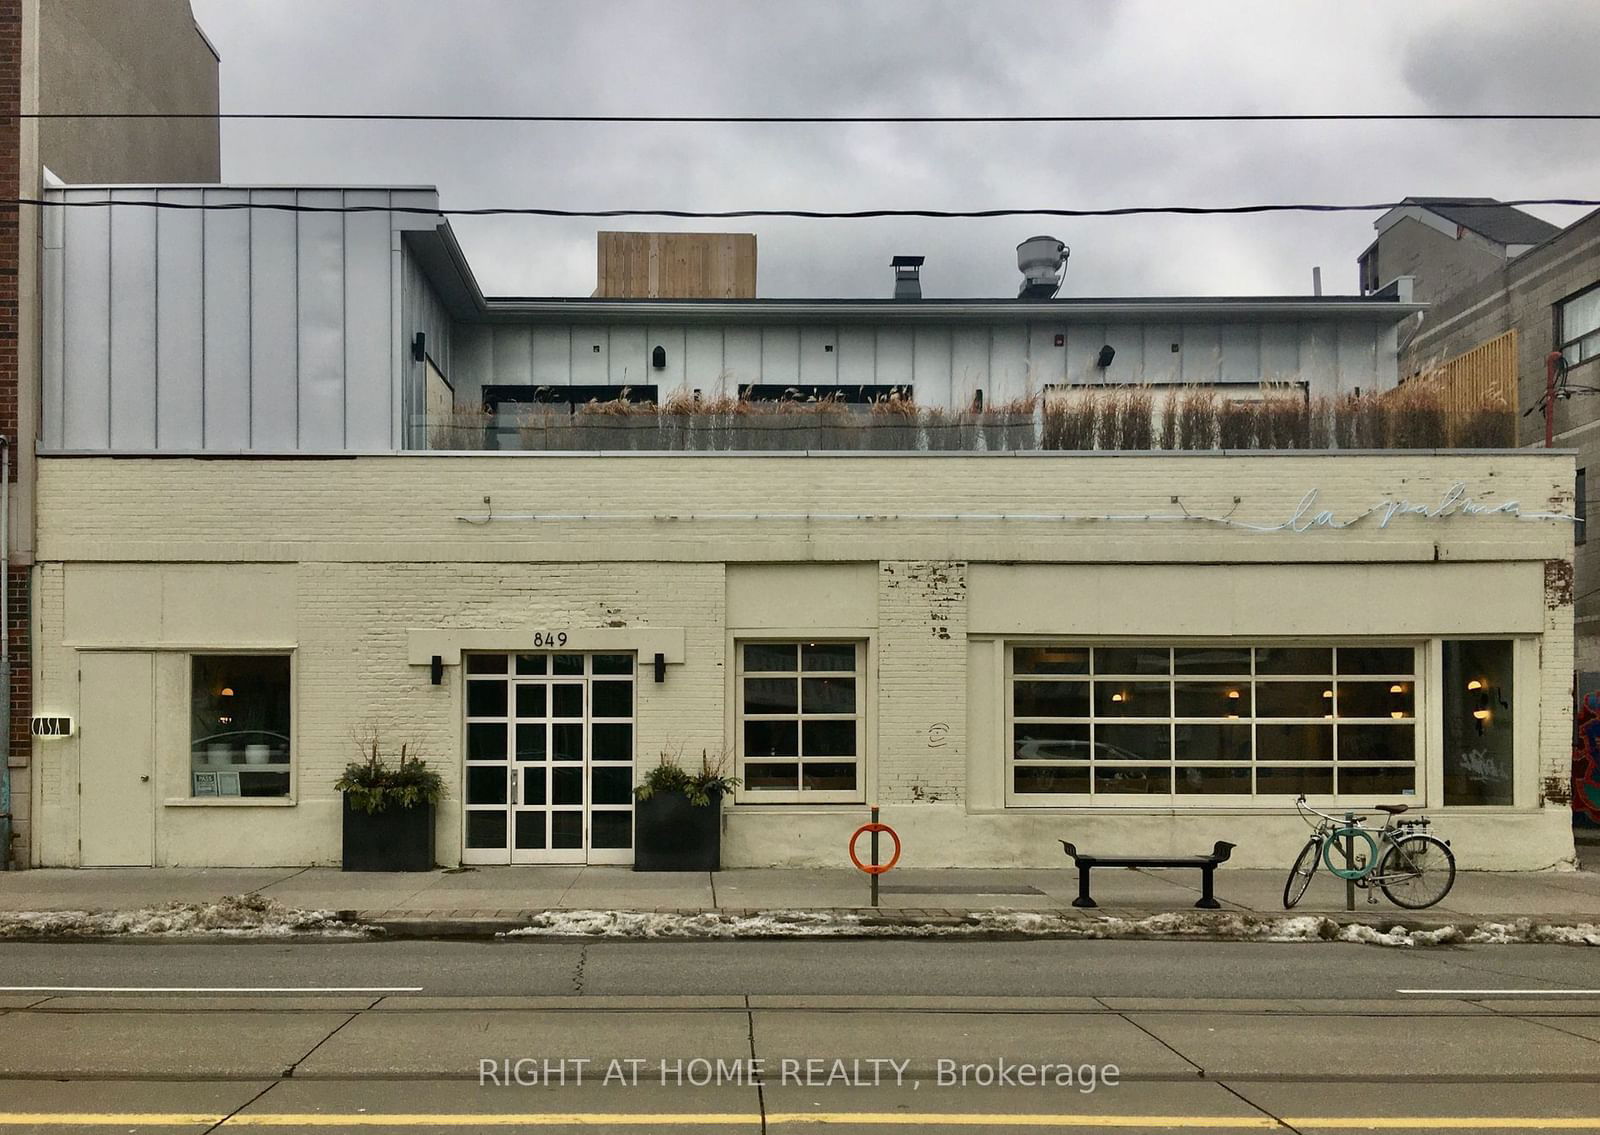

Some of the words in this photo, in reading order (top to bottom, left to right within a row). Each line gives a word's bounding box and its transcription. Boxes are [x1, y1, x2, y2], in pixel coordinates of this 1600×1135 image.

[1288, 487, 1345, 533] la
[1378, 481, 1521, 529] palma
[533, 631, 568, 648] 849
